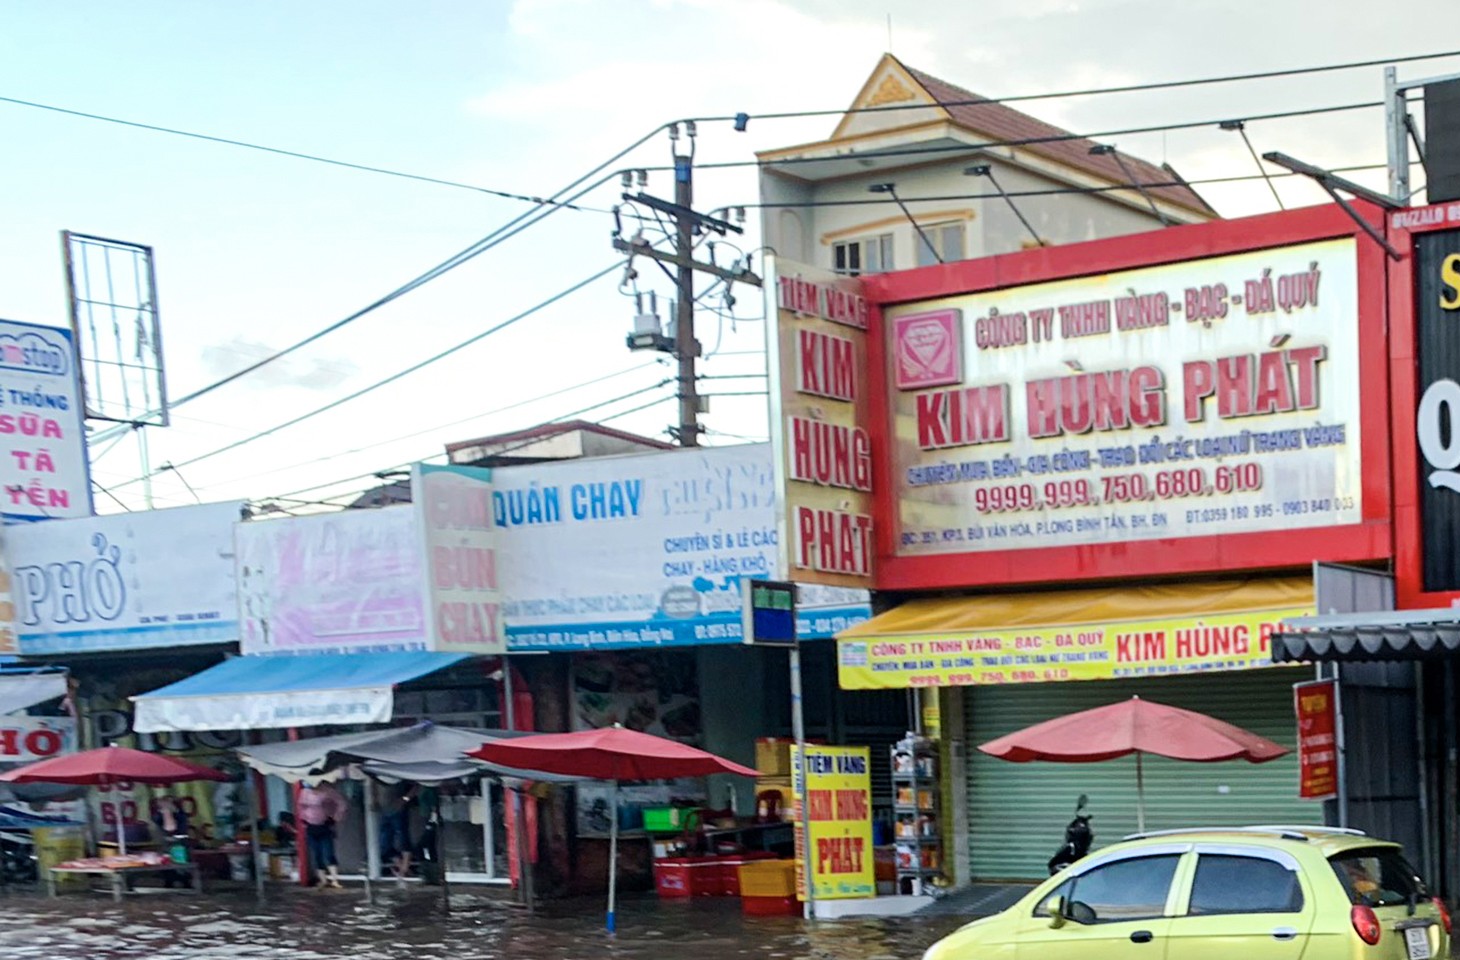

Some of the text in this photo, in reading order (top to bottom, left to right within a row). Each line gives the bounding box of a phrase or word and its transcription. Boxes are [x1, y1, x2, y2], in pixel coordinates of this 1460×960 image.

[975, 306, 1027, 350] CÔNG
[1029, 307, 1055, 344] TY
[1058, 300, 1111, 339] TNHH
[1114, 287, 1170, 332] VÀNG
[1184, 282, 1229, 329] BẠC
[1245, 267, 1276, 316] ĐÁ
[1277, 261, 1322, 314] QUÝ
[795, 328, 856, 403] KIM
[915, 333, 1329, 452] KIM HÙNG PHÁT
[8, 385, 70, 411] THỐNG
[787, 405, 872, 493] HÙNG
[1252, 428, 1303, 454] TRANG
[571, 478, 642, 521] CHAY
[793, 499, 873, 578] PHÁT
[15, 531, 126, 626] PHỞ
[910, 641, 924, 655] TY
[929, 638, 963, 654] TNHH
[966, 633, 1002, 652] VÀNG
[1115, 631, 1167, 663] KIM
[1175, 620, 1250, 659] HÙNG
[816, 828, 864, 874] PHÁT
